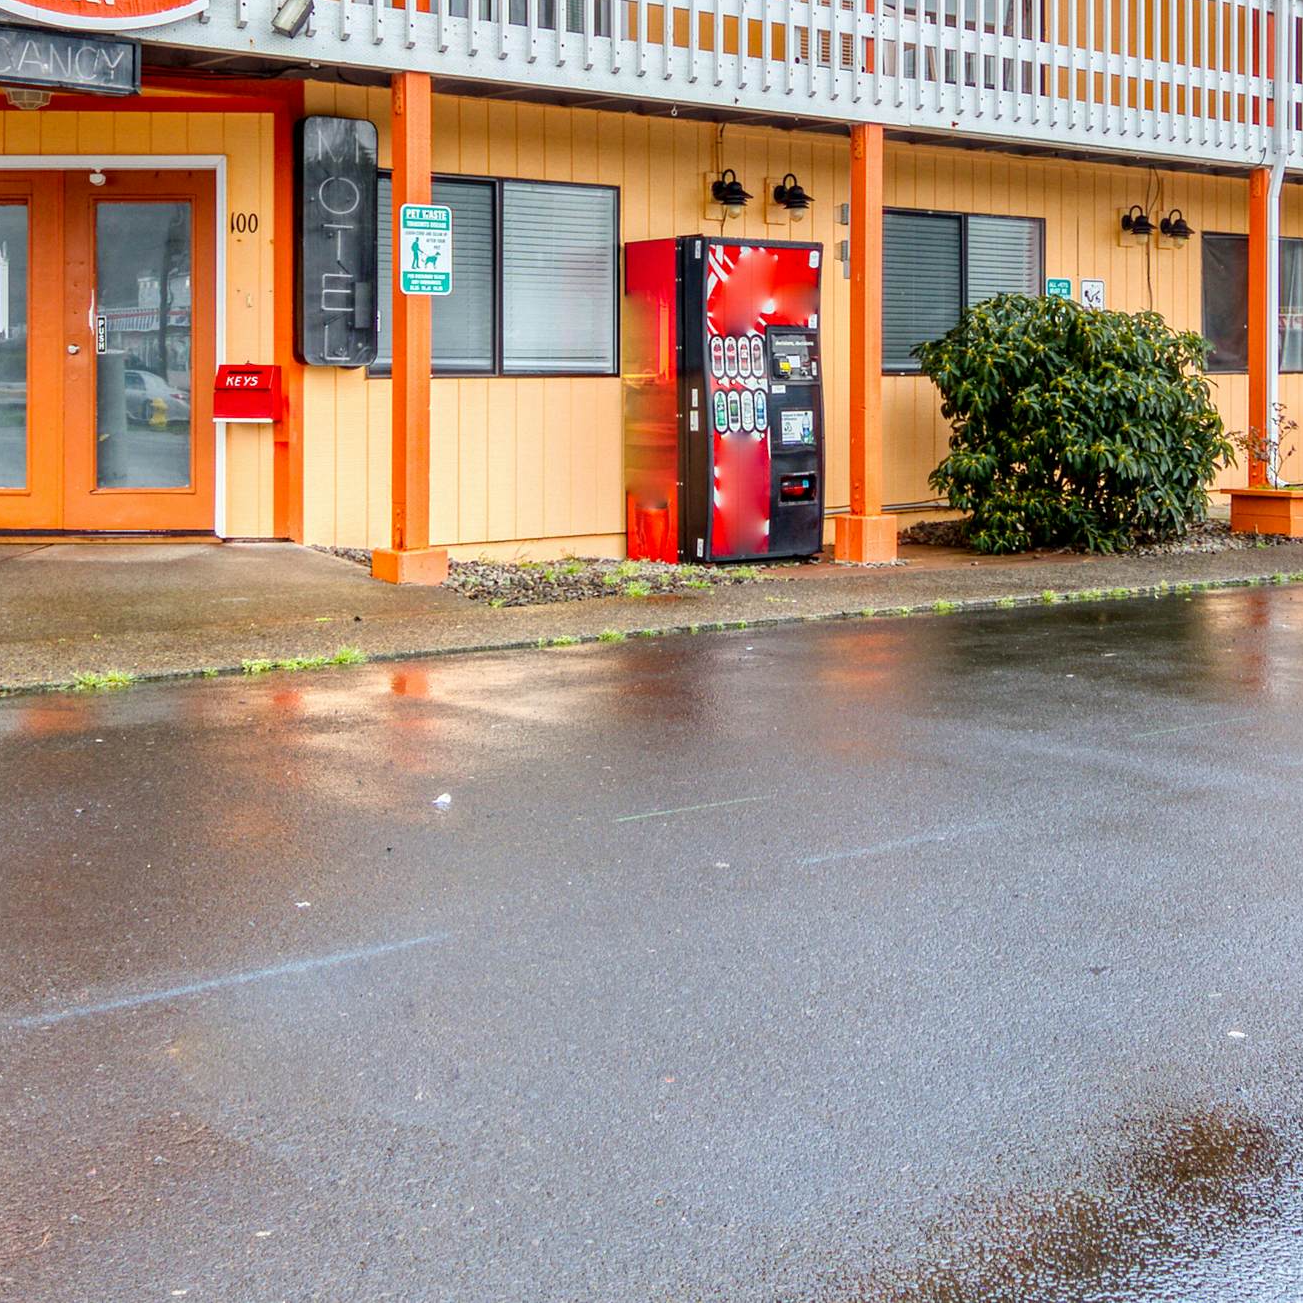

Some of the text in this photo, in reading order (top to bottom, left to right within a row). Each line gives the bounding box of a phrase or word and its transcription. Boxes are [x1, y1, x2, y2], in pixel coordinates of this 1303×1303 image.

[230, 212, 258, 234] 100
[406, 208, 448, 221] PET WASTE
[317, 128, 361, 362] MOTEL
[225, 375, 259, 388] KEYS
